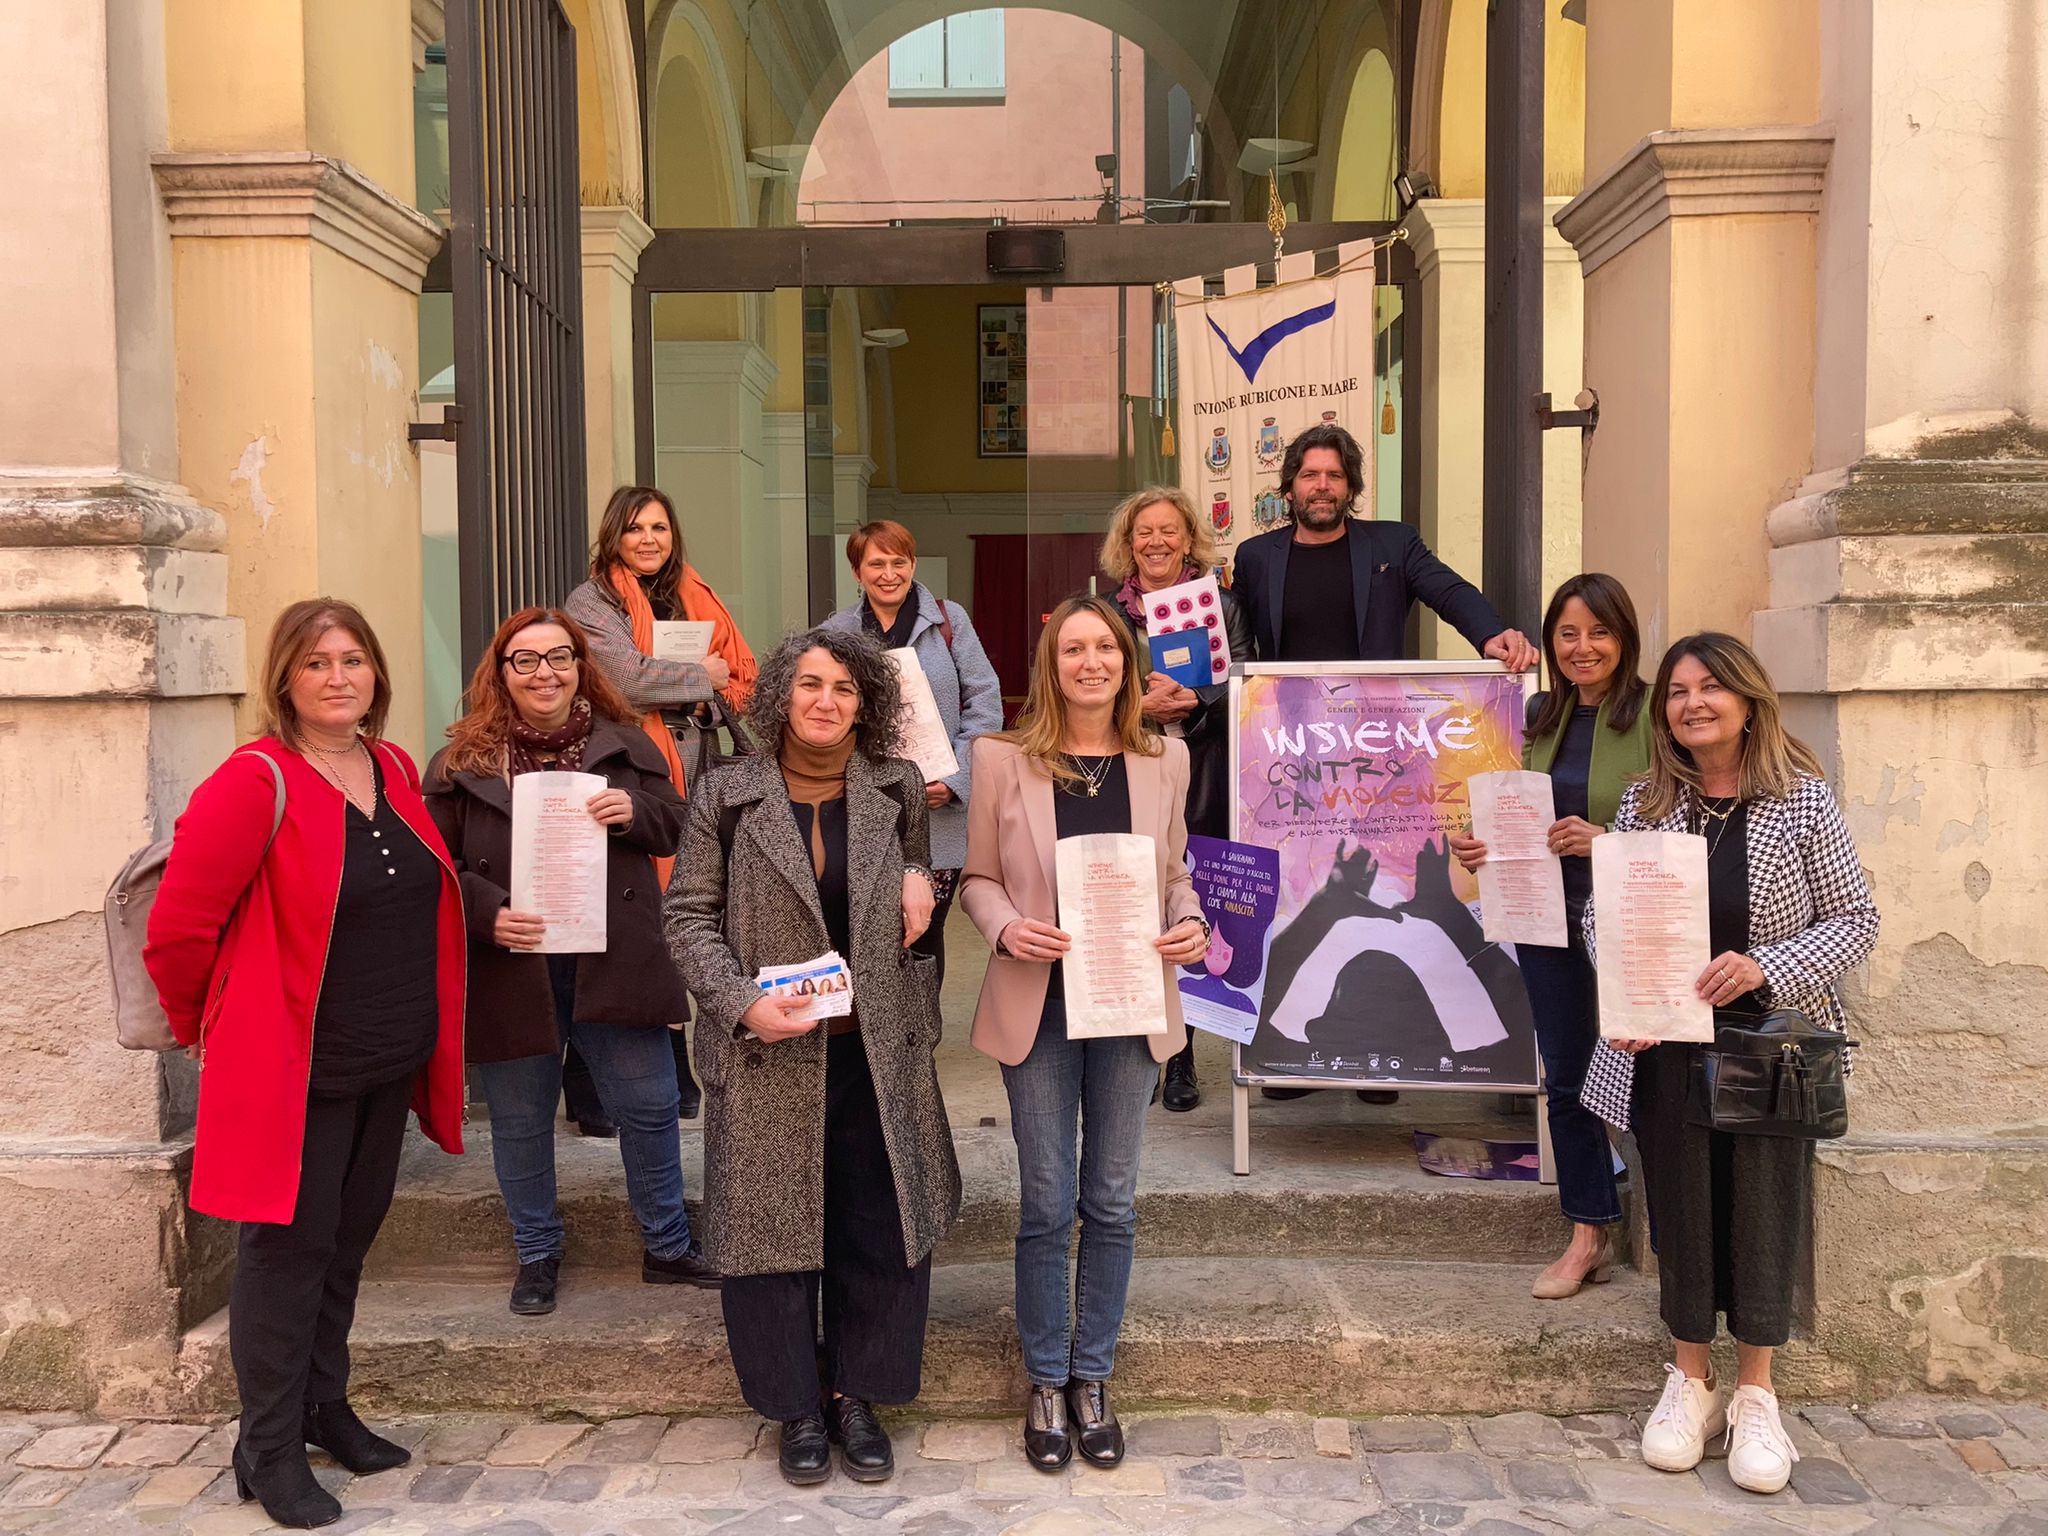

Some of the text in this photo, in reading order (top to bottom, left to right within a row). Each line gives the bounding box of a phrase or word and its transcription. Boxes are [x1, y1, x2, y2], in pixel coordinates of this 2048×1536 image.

[1193, 377, 1358, 416] UNIONE RUBICONE E MARE
[1327, 706, 1425, 714] GENERE E GENER-AZIONI
[1261, 717, 1479, 759] INSIEME
[1267, 757, 1405, 786] CONTRO
[1275, 781, 1470, 816] LA VIOLENZ
[1364, 815, 1426, 825] CONTRASTO
[1429, 813, 1453, 821] ALLA
[1300, 829, 1323, 837] ALLE
[1329, 826, 1410, 836] DISCRIMINAZIONI
[1426, 821, 1465, 832] GENER
[1229, 852, 1256, 865] SAVIGNANO
[1222, 864, 1245, 875] SPORTELLO
[1196, 871, 1211, 882] DELLE
[1214, 874, 1229, 886] DONNE
[1232, 879, 1242, 888] PER
[1246, 881, 1253, 890] LE
[1209, 884, 1214, 895] SI
[1217, 887, 1237, 900] CHIAMA
[1208, 897, 1221, 910] COME
